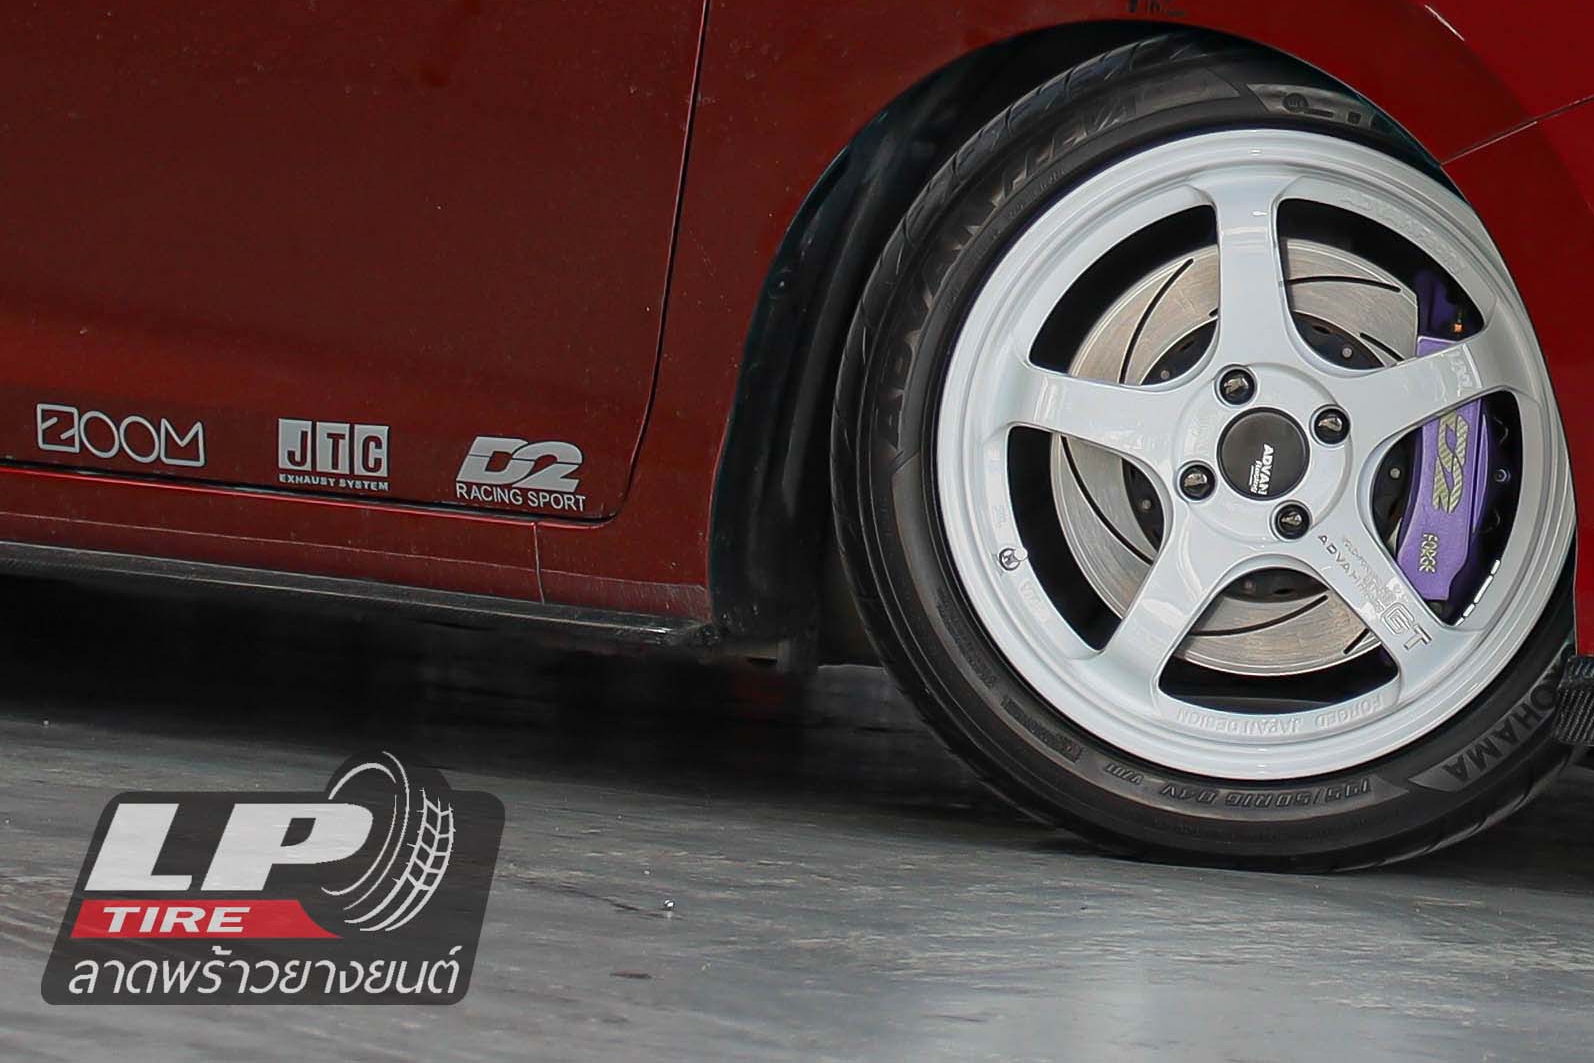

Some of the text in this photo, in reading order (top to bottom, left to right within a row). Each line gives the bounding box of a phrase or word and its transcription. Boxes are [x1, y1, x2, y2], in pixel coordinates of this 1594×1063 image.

[278, 418, 390, 477] JTC
[456, 435, 583, 493] D2
[1258, 443, 1275, 495] ADVAN
[279, 473, 389, 491] EXHAUST SYSTEM
[456, 482, 586, 512] RACING SPORT
